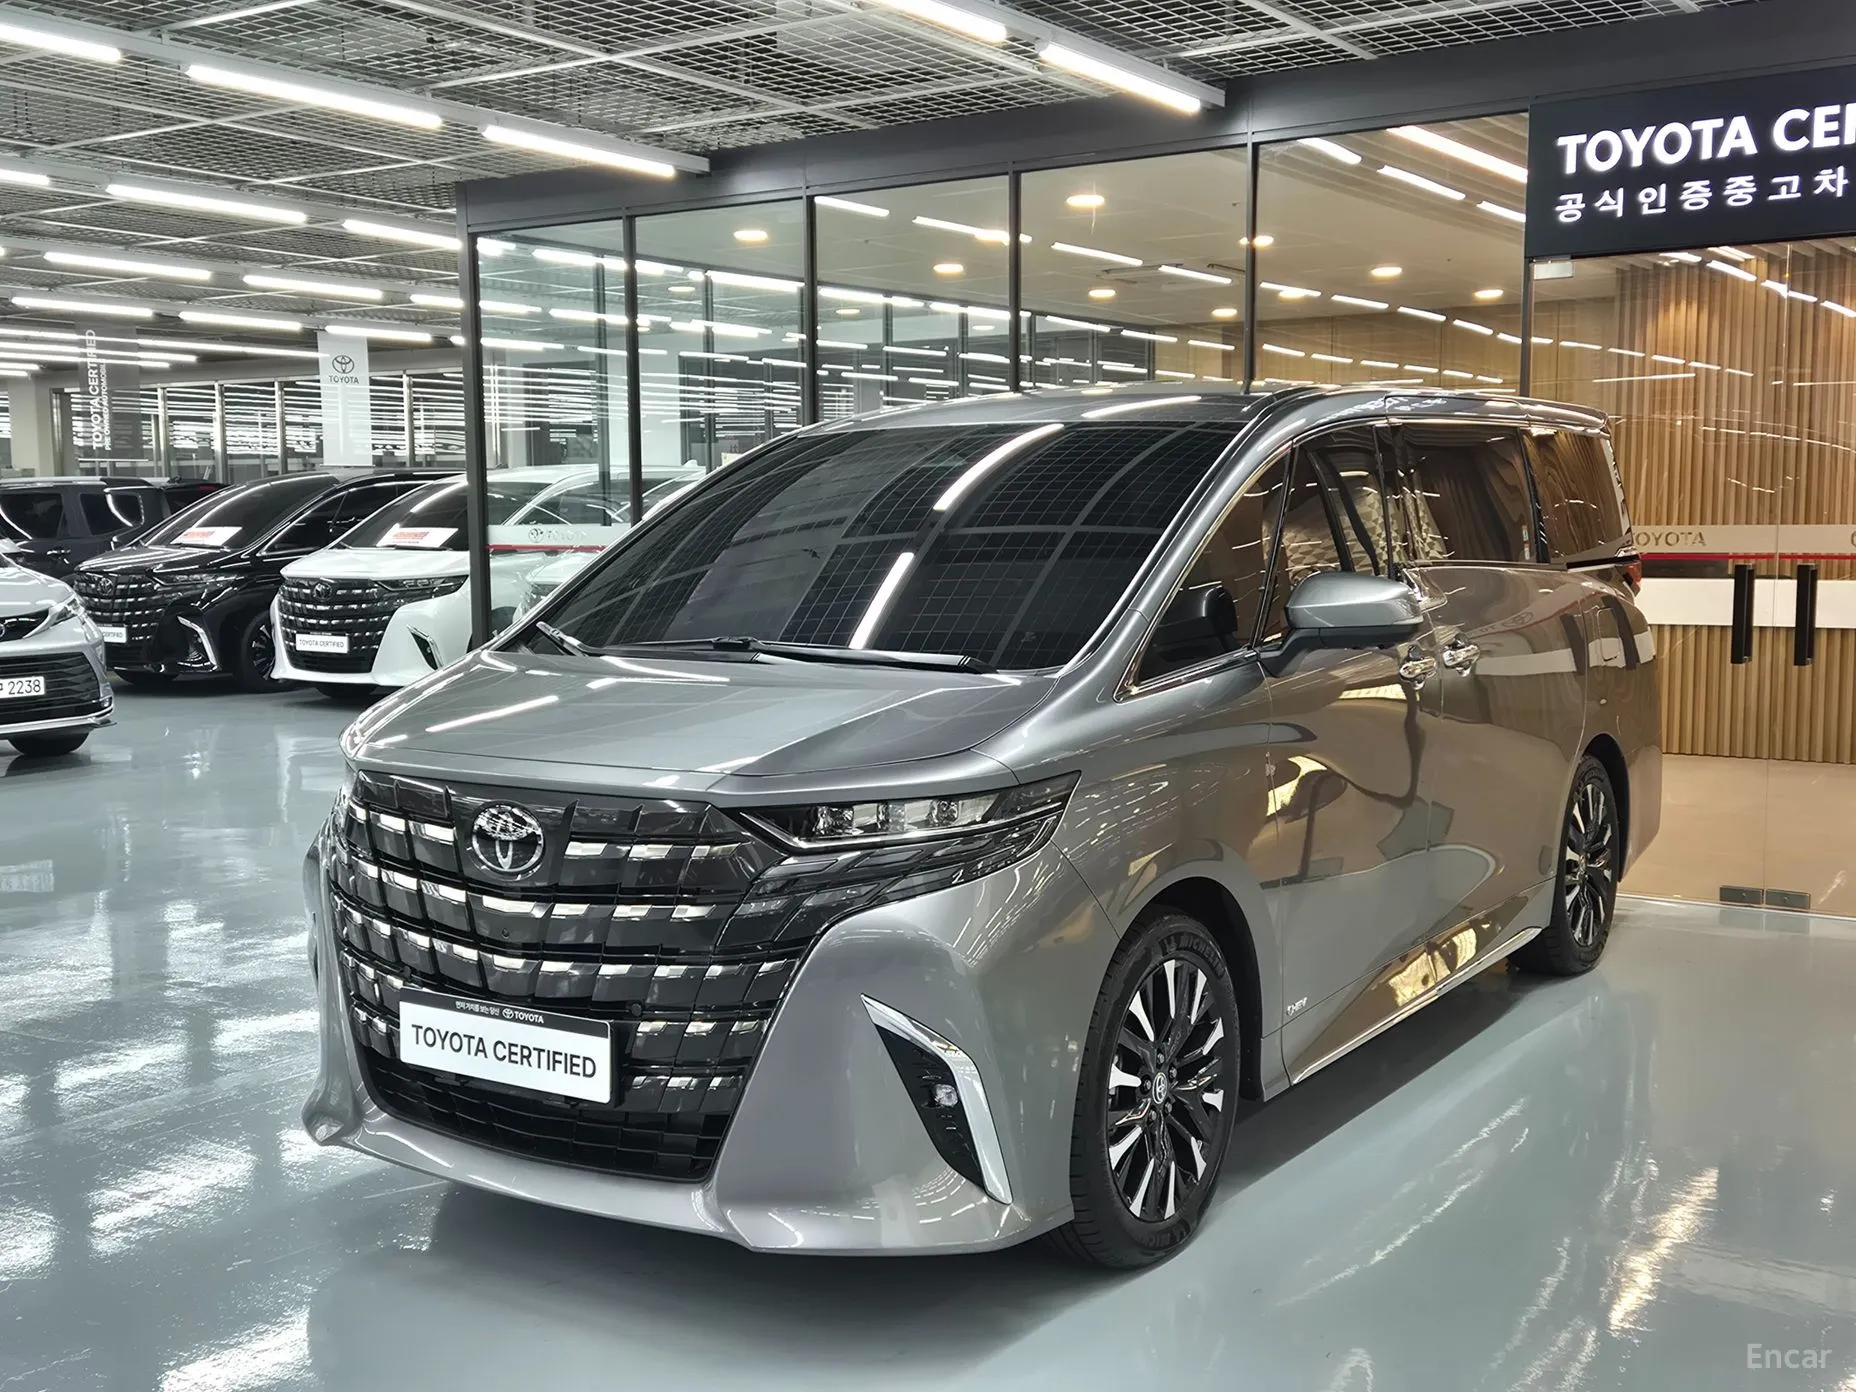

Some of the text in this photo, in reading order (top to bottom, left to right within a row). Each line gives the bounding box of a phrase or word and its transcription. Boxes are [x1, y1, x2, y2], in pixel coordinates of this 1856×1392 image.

[1556, 115, 1758, 175] TOYOTA
[328, 375, 359, 384] TOYOTA
[91, 396, 104, 450] TOYOTA
[1632, 531, 1707, 547] OYOTA
[8, 678, 41, 695] 2238
[514, 1010, 544, 1024] TOYOTA
[412, 1023, 597, 1079] TOYOTA CERTIFIED
